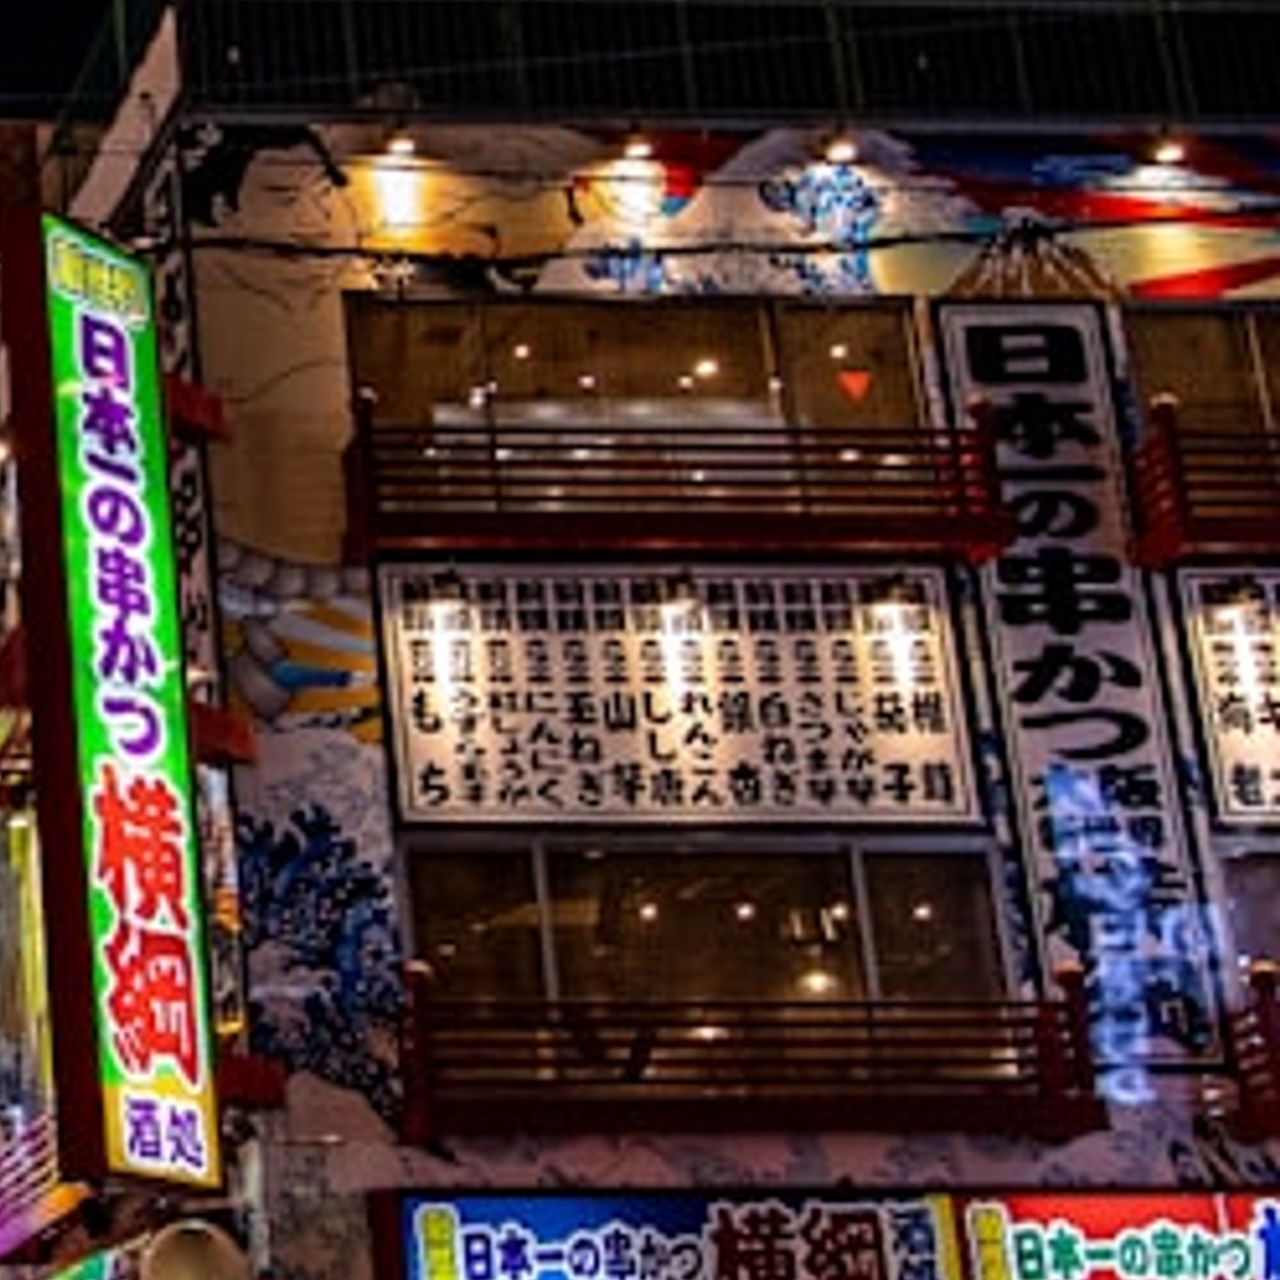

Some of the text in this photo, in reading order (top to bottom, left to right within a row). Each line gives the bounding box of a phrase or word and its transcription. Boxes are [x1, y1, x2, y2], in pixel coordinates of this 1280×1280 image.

[80, 314, 166, 762] 日本一の串かつ
[964, 325, 1150, 762] 日本一の串かつ
[90, 762, 202, 1086] 横綱
[1012, 1225, 1251, 1280] 日本一の串かつ
